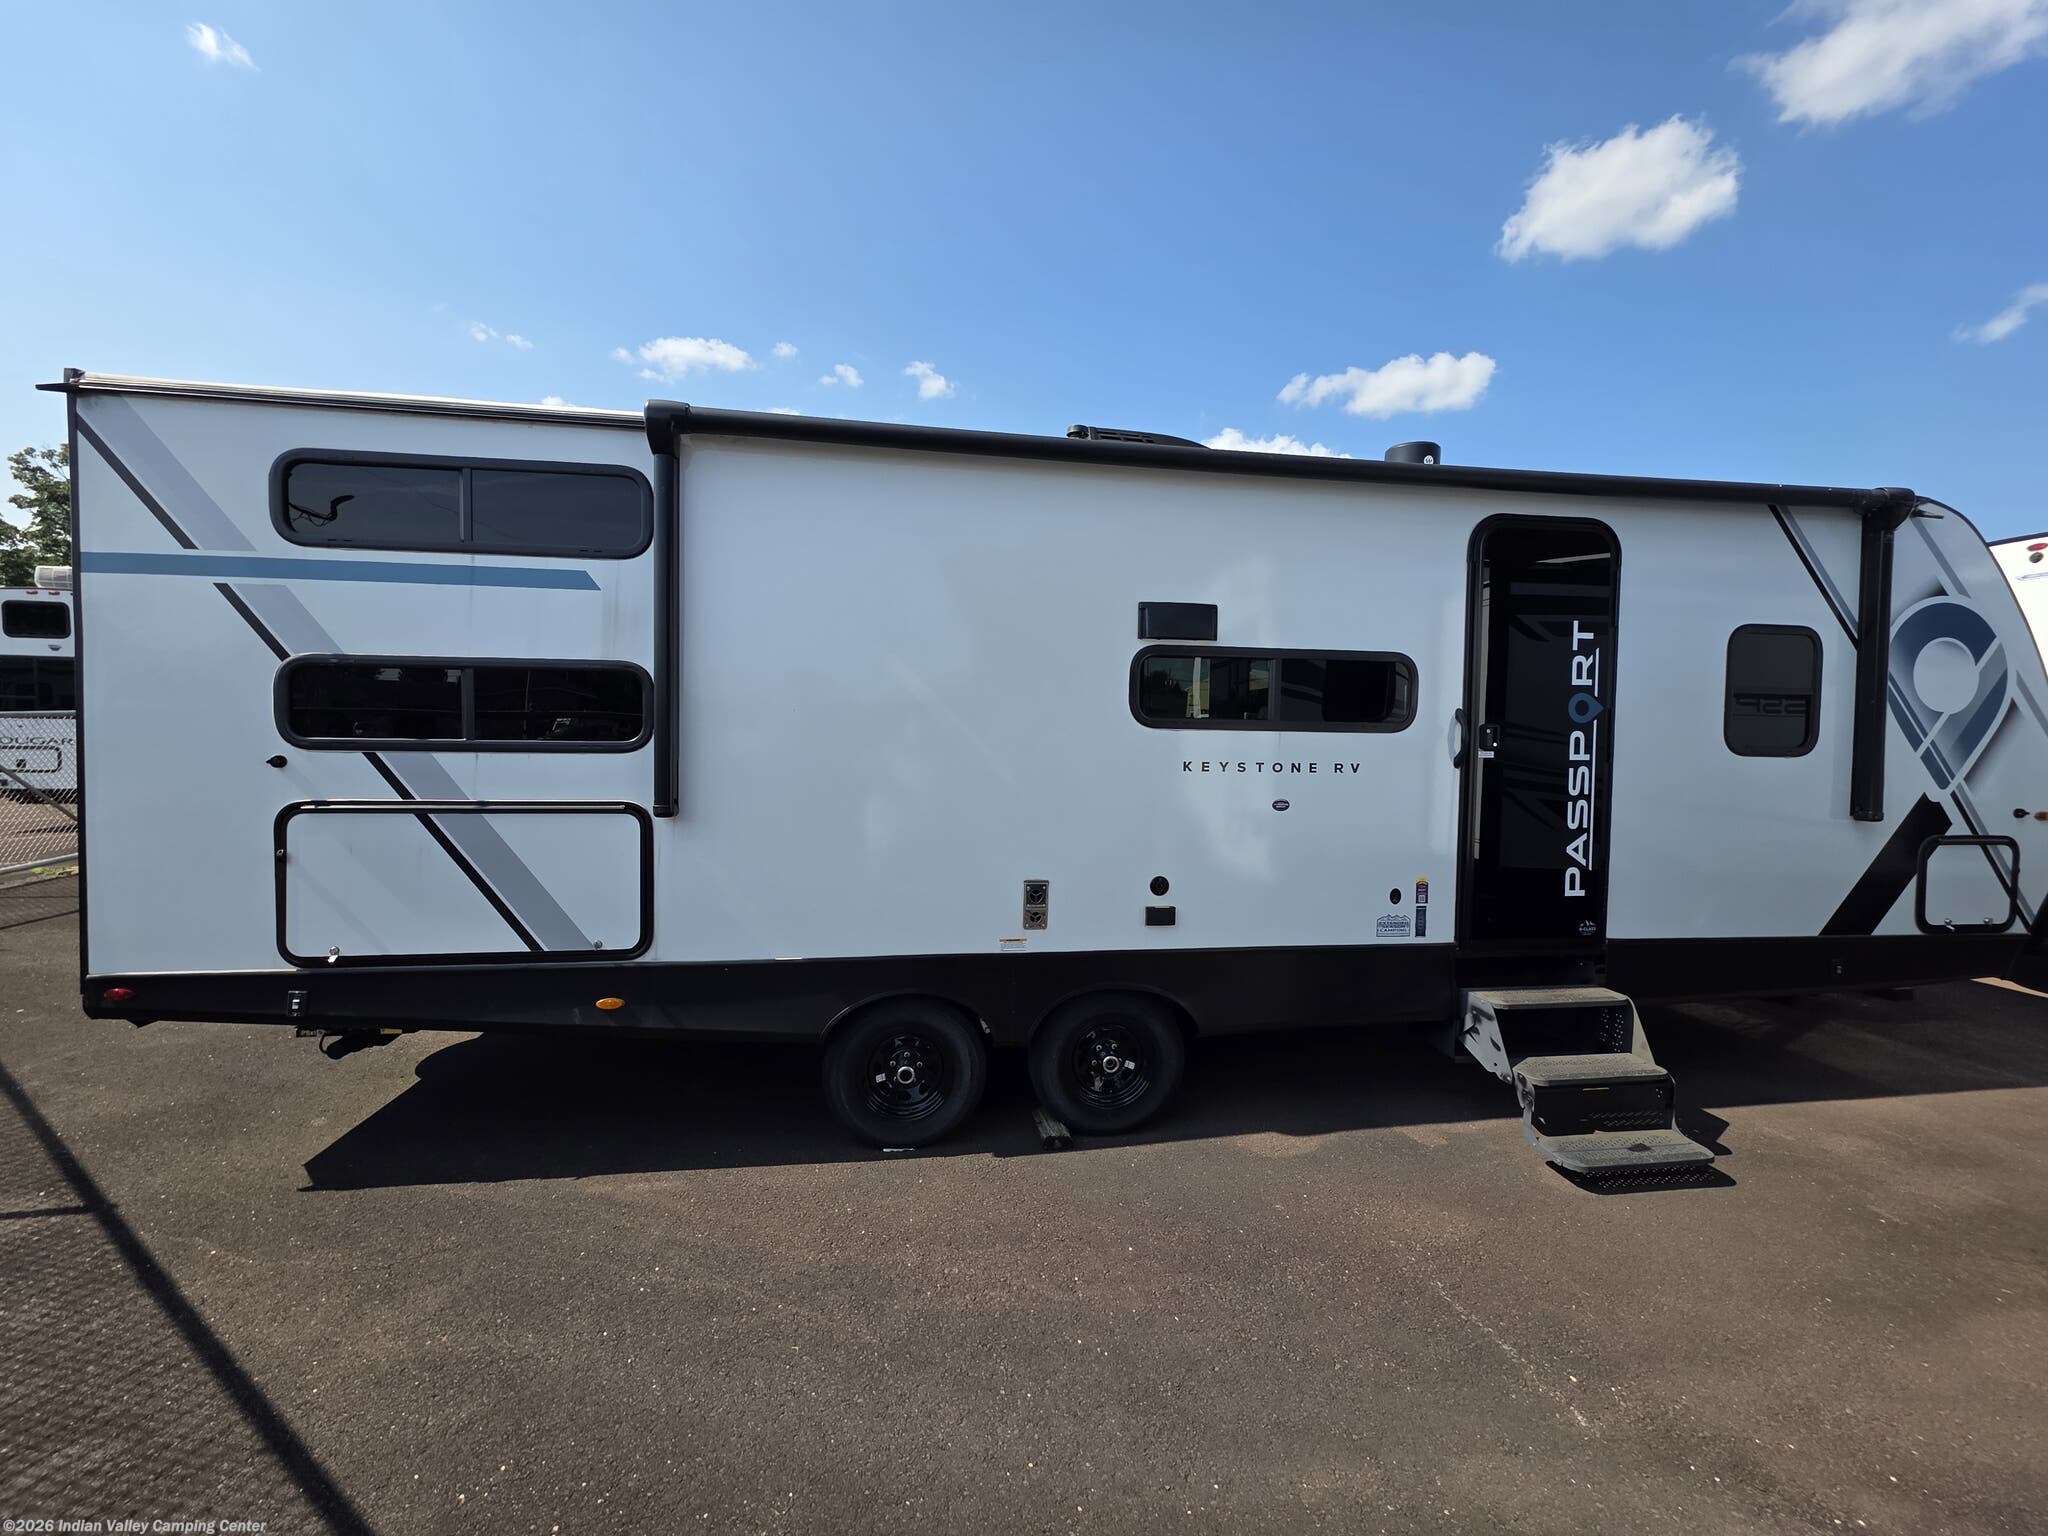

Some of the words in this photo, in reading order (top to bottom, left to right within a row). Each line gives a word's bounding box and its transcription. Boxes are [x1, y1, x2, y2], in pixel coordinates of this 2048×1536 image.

[1183, 761, 1317, 774] KEYSTONE
[1334, 763, 1361, 774] RV
[1564, 620, 1605, 897] PASSPORT
